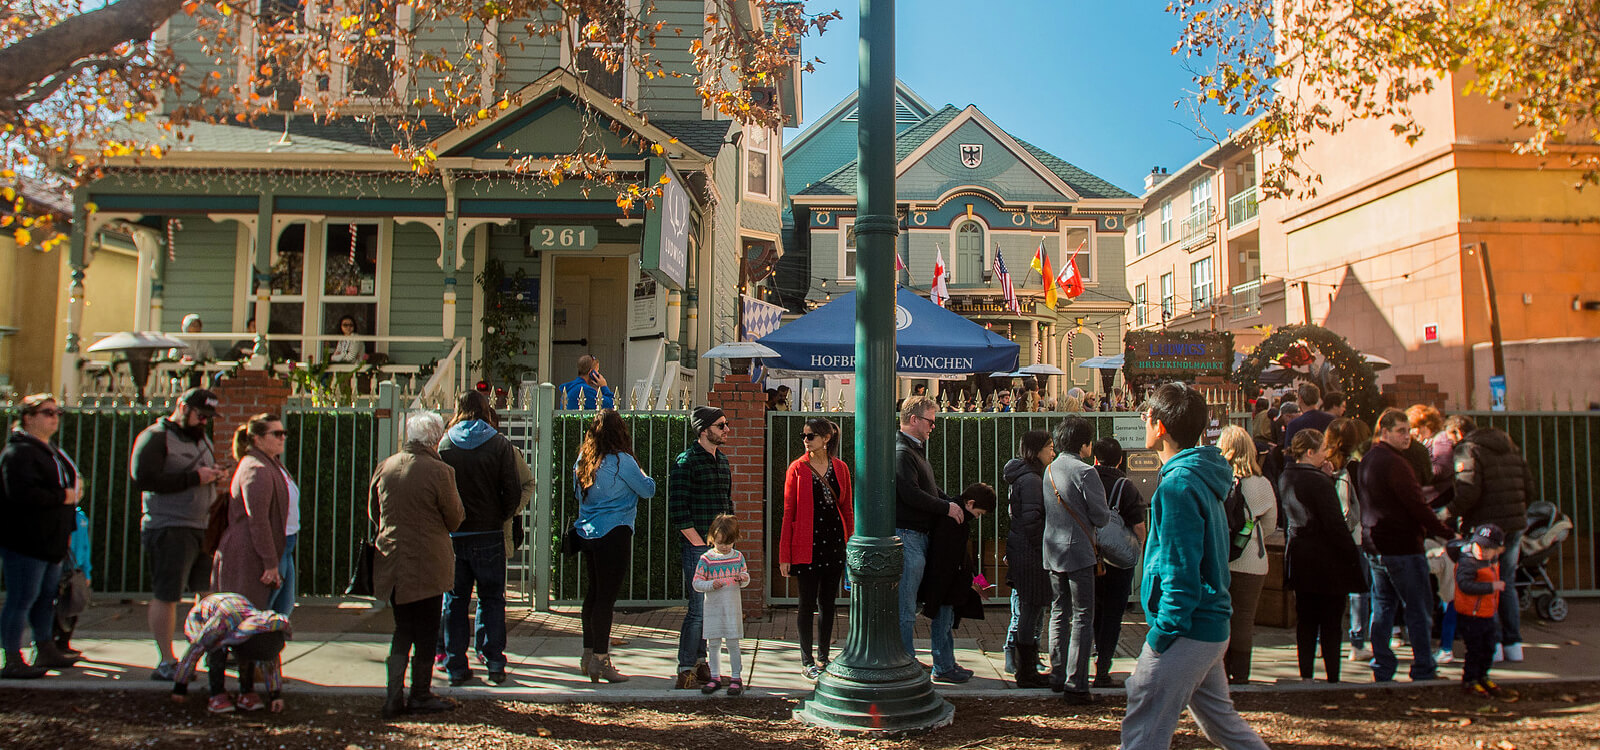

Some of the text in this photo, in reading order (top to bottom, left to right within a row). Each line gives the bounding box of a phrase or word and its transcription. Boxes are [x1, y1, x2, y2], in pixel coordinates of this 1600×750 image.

[541, 228, 585, 246] 261
[1149, 343, 1206, 355] LUDWIGS
[811, 355, 973, 370] HOFBR MÜNCHEN
